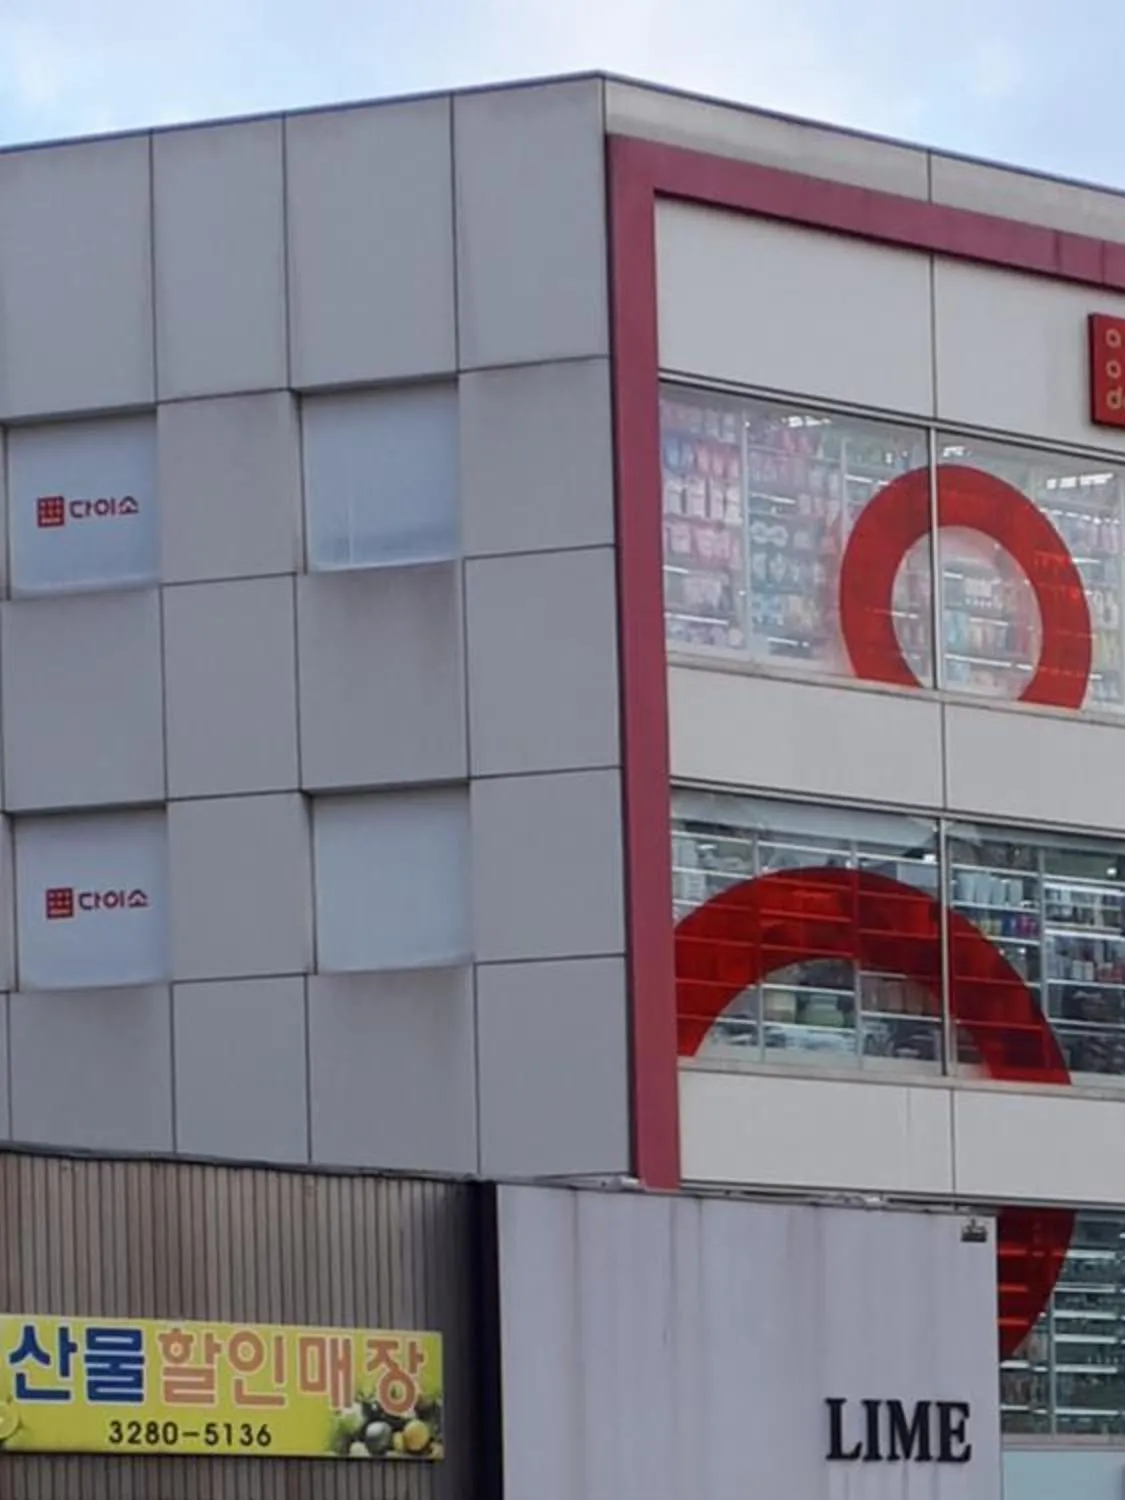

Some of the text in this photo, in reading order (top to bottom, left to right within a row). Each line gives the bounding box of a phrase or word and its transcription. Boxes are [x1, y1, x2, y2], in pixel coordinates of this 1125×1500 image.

[69, 495, 139, 519] 다이소
[78, 888, 148, 911] 다이소
[109, 1421, 272, 1447] 3280-5136
[825, 1397, 972, 1462] LIME
